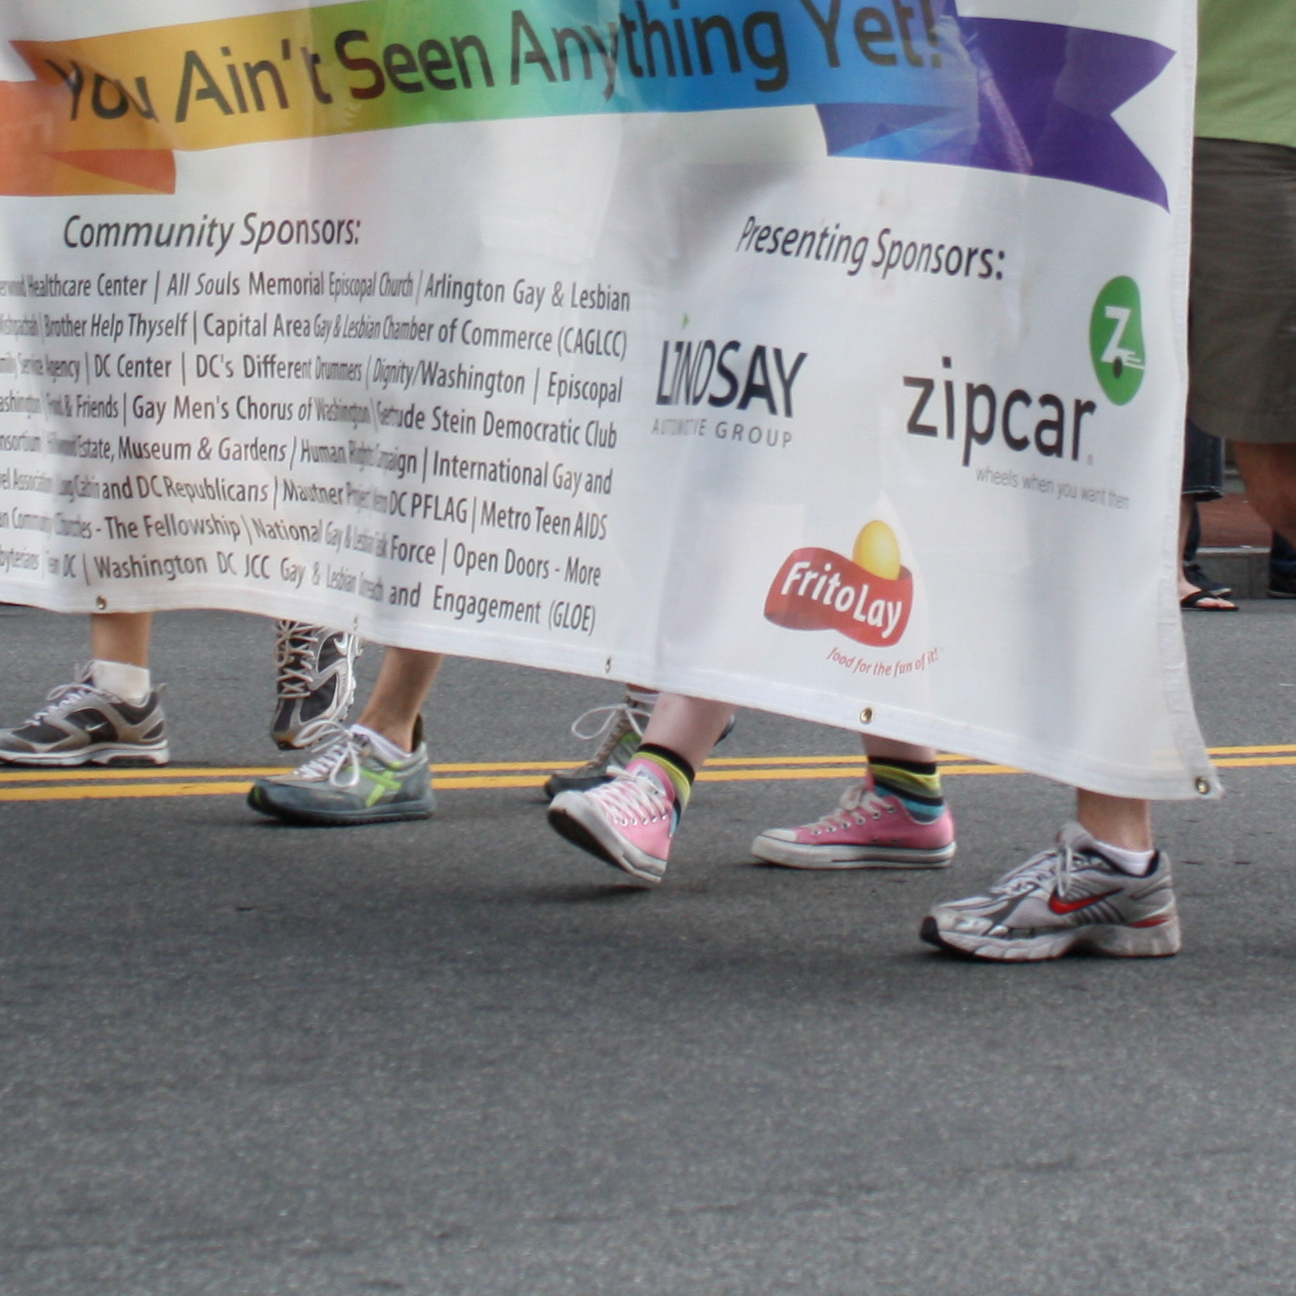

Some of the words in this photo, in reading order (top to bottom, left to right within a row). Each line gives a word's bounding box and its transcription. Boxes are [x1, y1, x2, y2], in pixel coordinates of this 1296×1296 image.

[45, 57, 159, 122] You
[174, 38, 334, 124] Ain't
[332, 28, 494, 100] Seen
[63, 213, 235, 256] Community
[240, 212, 360, 254] Sponsors:
[735, 216, 869, 276] Presenting
[871, 227, 1006, 281] Sponsors:
[27, 272, 91, 297] Healthcare
[97, 272, 147, 297] Center
[166, 271, 191, 297] All
[194, 270, 240, 296] Souls
[249, 270, 324, 297] Memorial
[329, 270, 376, 303] Episcopal
[379, 271, 413, 297] Church
[423, 272, 505, 307] Arlington
[512, 278, 547, 313] Gay
[551, 281, 564, 308] &
[570, 282, 630, 312] Lesbian
[44, 313, 87, 337] Brother
[90, 313, 123, 343] Help
[128, 311, 189, 343] Thyself
[203, 312, 268, 344] Capital
[273, 313, 310, 338] Area
[314, 312, 332, 344] Gay
[332, 314, 341, 338] &
[342, 313, 380, 340] Lesbian
[383, 314, 435, 342] Chamber
[438, 317, 458, 344] of
[461, 319, 552, 352] Commerce
[557, 325, 627, 361] (CAGLCC)
[94, 354, 111, 377] DC
[117, 354, 171, 378] Center
[196, 354, 234, 378] DC's
[243, 354, 311, 379] Different
[315, 355, 362, 382] Drummers
[373, 357, 526, 399] Dignity/Washington
[547, 371, 623, 408] Episcopal
[656, 339, 809, 418] LINDSAY
[76, 393, 118, 419] Friends
[132, 395, 167, 425] Gay
[173, 395, 230, 420] Men's
[236, 395, 293, 421] Chorus
[297, 396, 313, 421] of
[431, 406, 476, 435] Stein
[483, 411, 580, 445] Democratic
[585, 420, 617, 449] Club
[715, 421, 792, 449] GROUP
[903, 356, 1097, 467] zipcar
[118, 435, 192, 461] Museum
[197, 437, 213, 461] &
[218, 437, 287, 462] Gardens
[300, 438, 347, 464] Human
[433, 451, 549, 487] International
[553, 463, 581, 498] Gay
[584, 468, 613, 495] and
[103, 476, 133, 500] and
[137, 475, 163, 498] DC
[164, 475, 268, 504] Republicans
[282, 478, 344, 505] Mautner
[389, 490, 408, 517] DC
[411, 493, 468, 523] PFLAG
[480, 500, 531, 531] Metro
[535, 506, 571, 537] Teen
[574, 512, 607, 540] AIDS
[105, 516, 139, 540] The
[143, 513, 241, 542] Fellowship
[251, 517, 323, 544] National
[391, 535, 436, 565] Force
[454, 542, 498, 576] Open
[504, 548, 549, 579] Doors
[564, 556, 601, 587] More
[93, 554, 208, 580] Washington
[216, 551, 238, 576] DC
[244, 554, 271, 580] JCC
[280, 557, 305, 590] Gay
[311, 561, 321, 586] &
[388, 582, 422, 608] and
[433, 584, 541, 625] Engagement
[548, 599, 595, 637] (GLOE)
[781, 561, 902, 639] FritoLay
[826, 647, 856, 668] food
[852, 658, 872, 674] for
[873, 662, 891, 676] the
[893, 661, 913, 678] fun
[915, 653, 925, 671] of
[927, 647, 939, 664] it!
